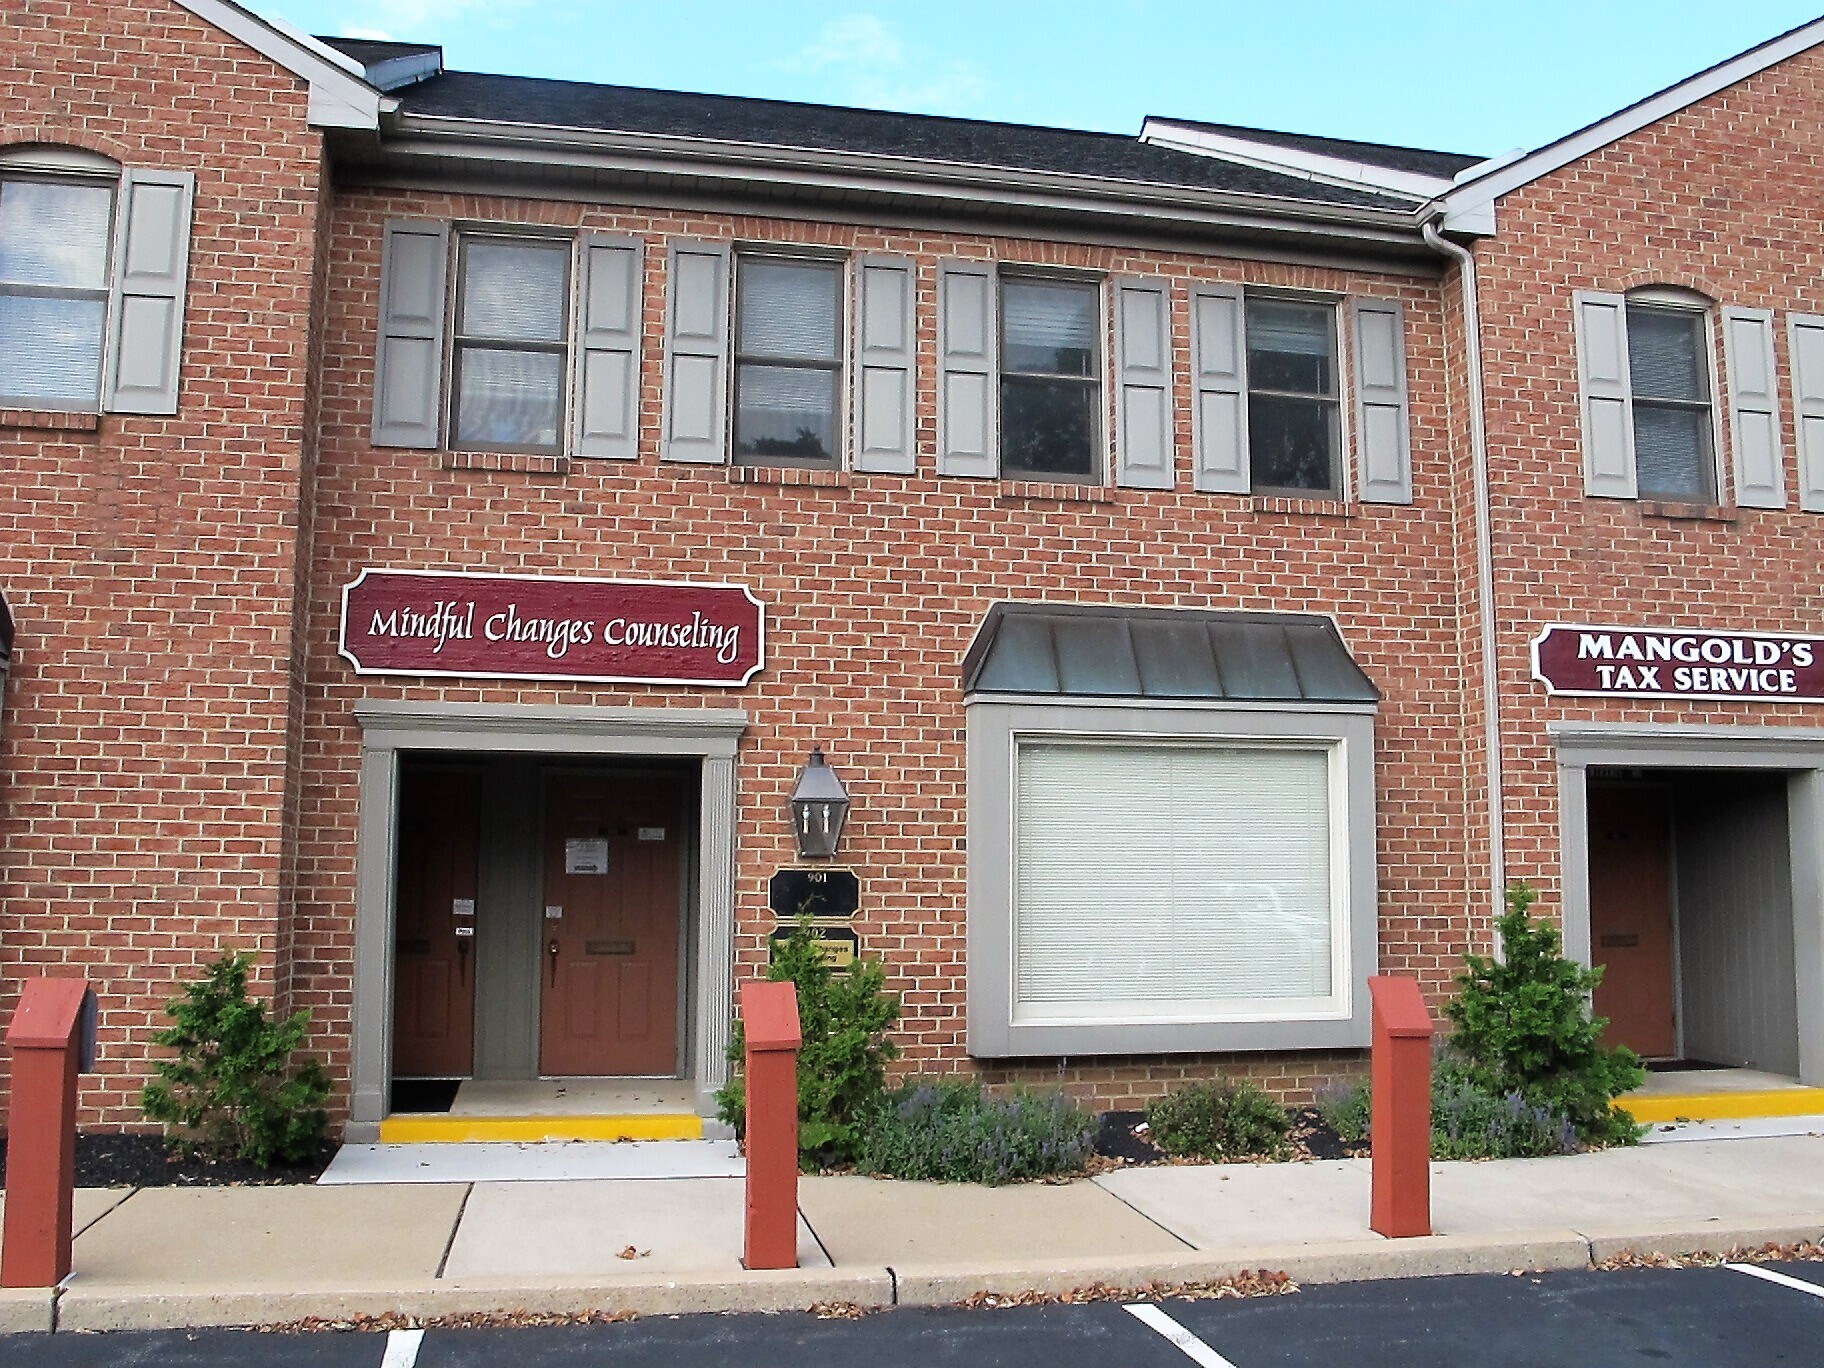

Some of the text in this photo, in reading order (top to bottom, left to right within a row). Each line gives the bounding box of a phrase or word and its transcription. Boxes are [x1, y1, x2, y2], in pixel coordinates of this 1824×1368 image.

[369, 600, 740, 664] Mindful Changes Counseling
[1578, 633, 1814, 667] MANGOLD'S
[1596, 665, 1797, 692] TAX SERVICE
[807, 872, 827, 883] 901
